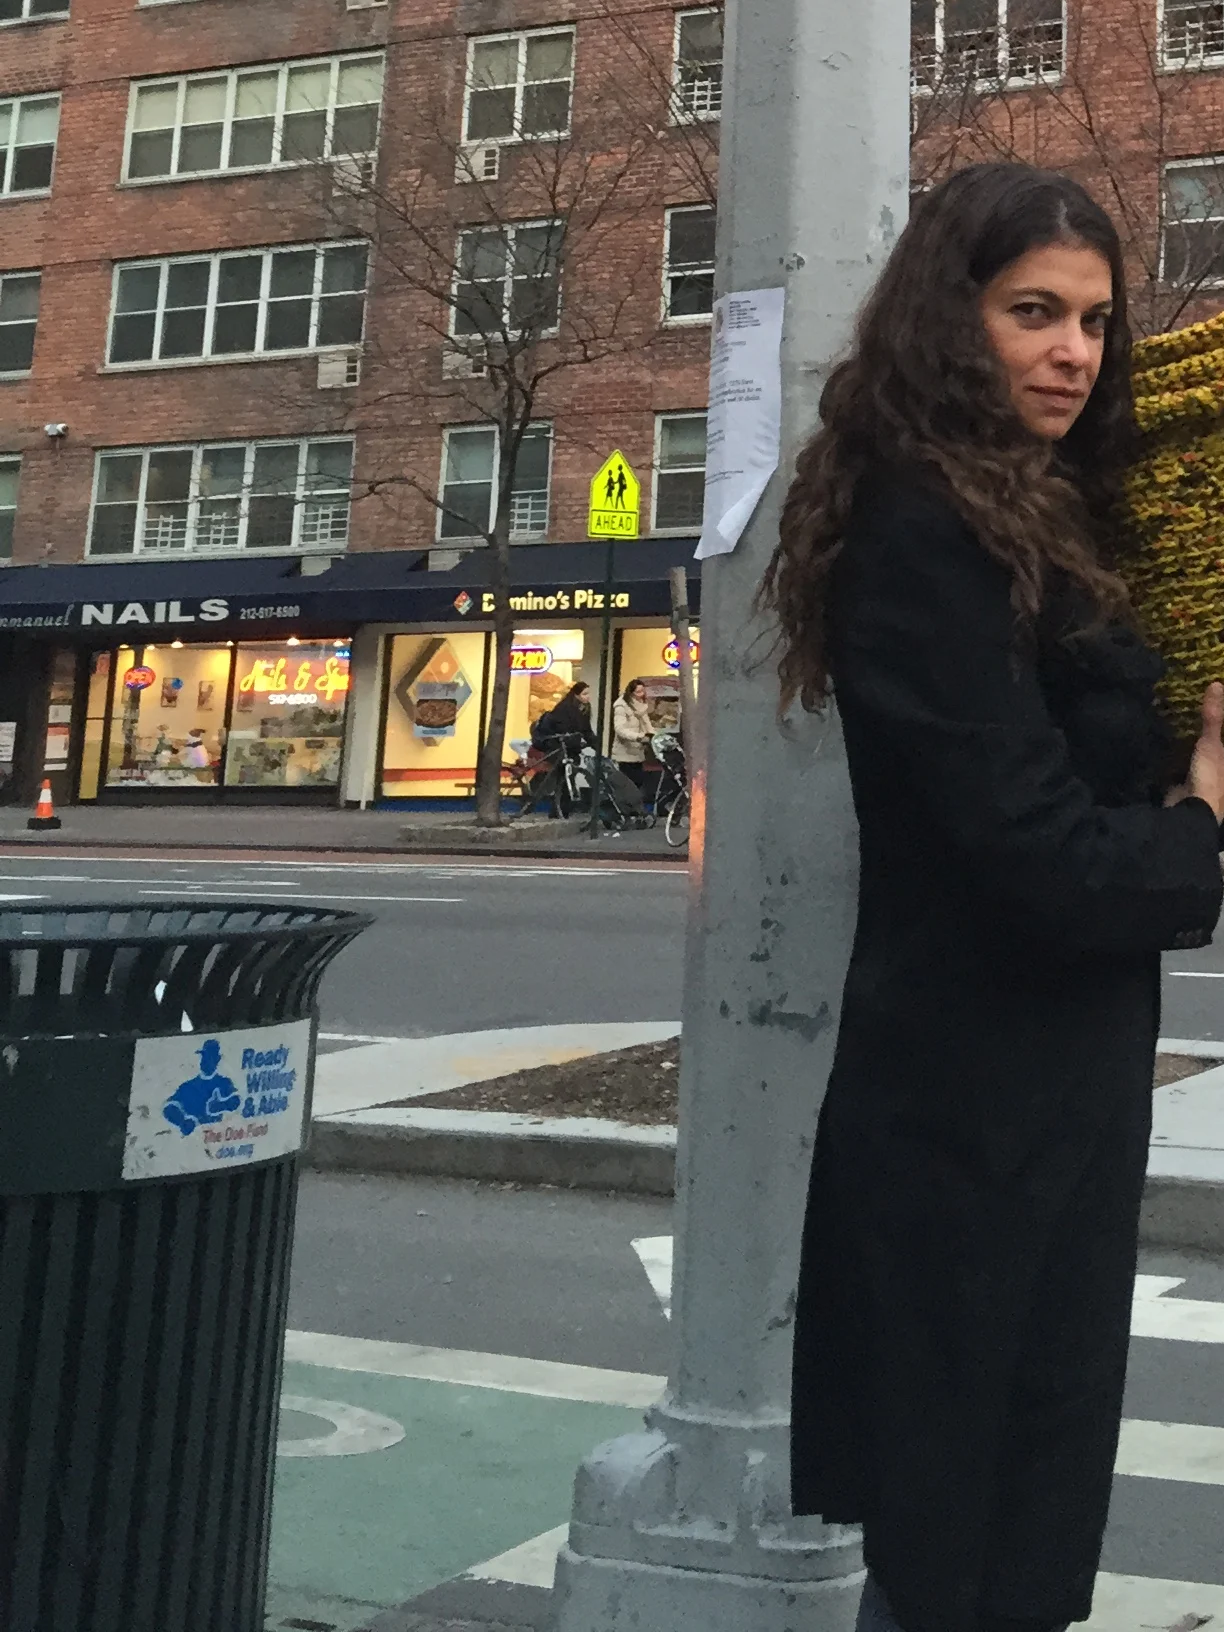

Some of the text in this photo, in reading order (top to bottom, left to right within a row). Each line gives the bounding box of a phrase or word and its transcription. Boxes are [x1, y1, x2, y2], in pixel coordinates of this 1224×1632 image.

[595, 515, 633, 531] AHEAD
[82, 598, 230, 625] NAILS
[482, 591, 569, 612] Dmino's
[241, 1044, 290, 1070] Ready
[246, 1068, 297, 1093] Willing
[242, 1093, 289, 1118] & Able
[203, 1129, 222, 1144] The
